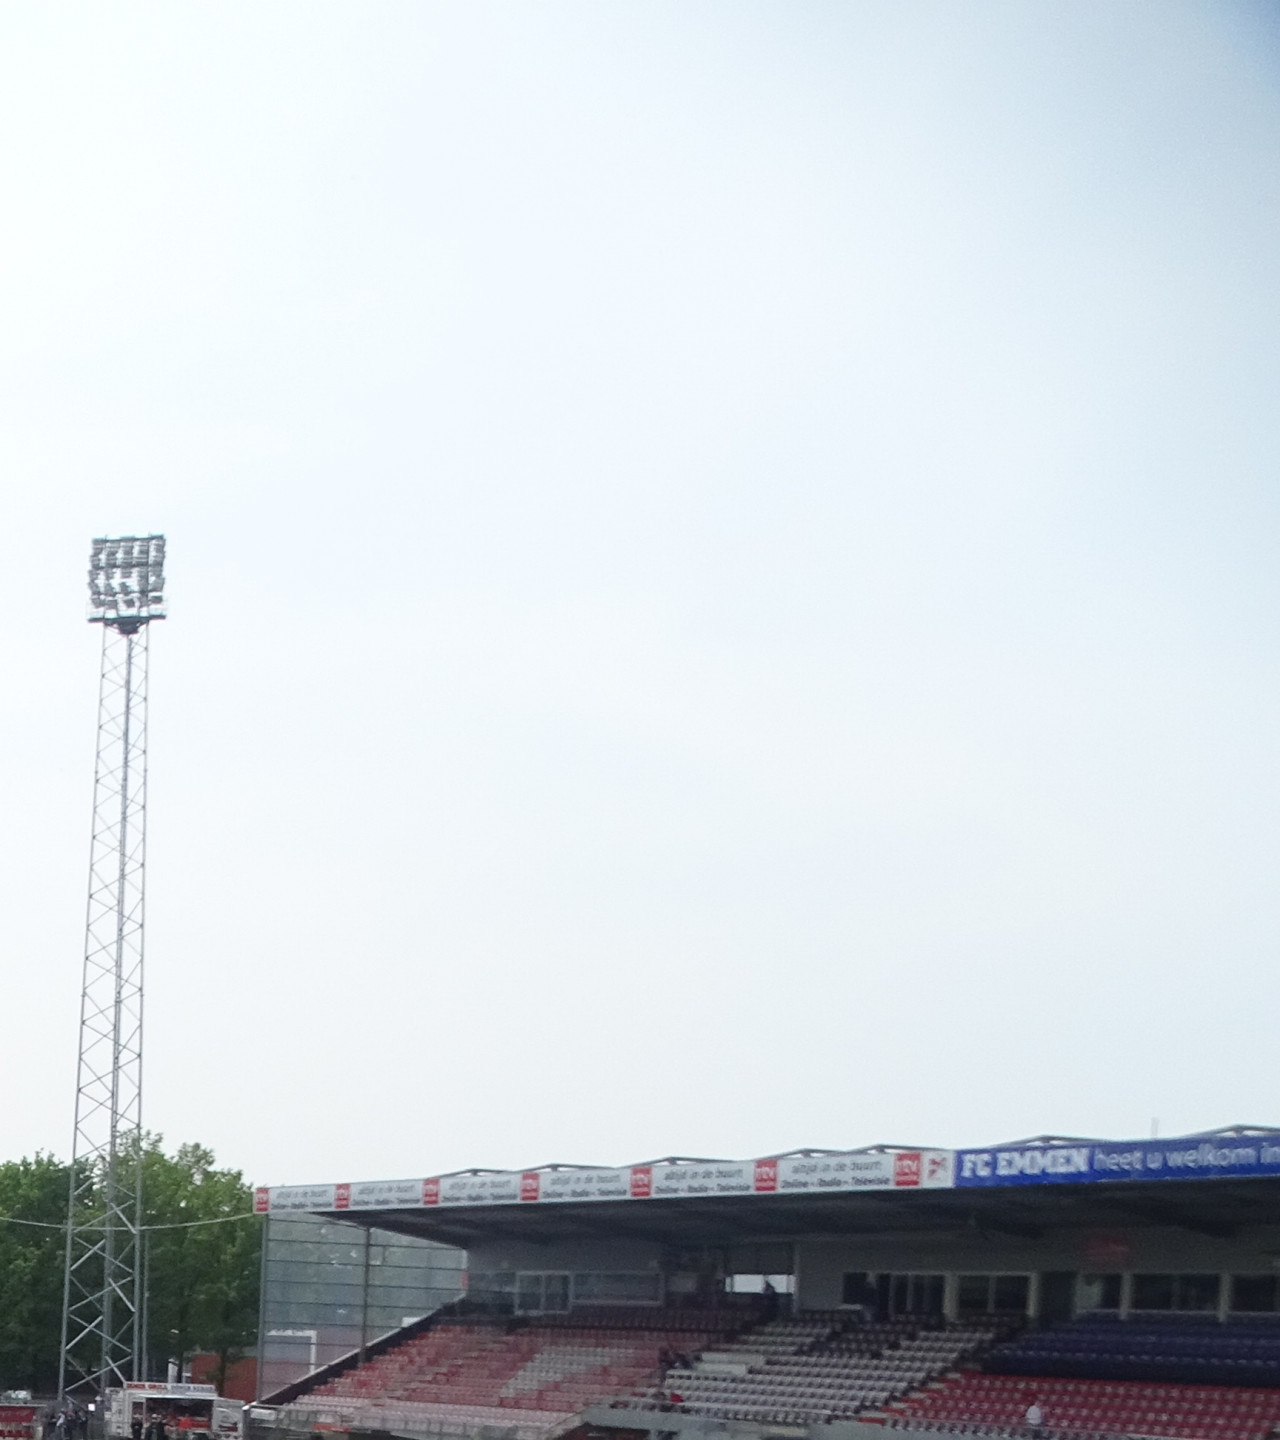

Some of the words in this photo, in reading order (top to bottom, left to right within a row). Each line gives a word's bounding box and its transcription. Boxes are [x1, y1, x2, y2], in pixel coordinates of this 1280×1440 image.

[960, 1153, 992, 1178] FC
[995, 1147, 1090, 1176] EMMEN
[1094, 1148, 1144, 1171] heet
[1165, 1143, 1257, 1169] welkom
